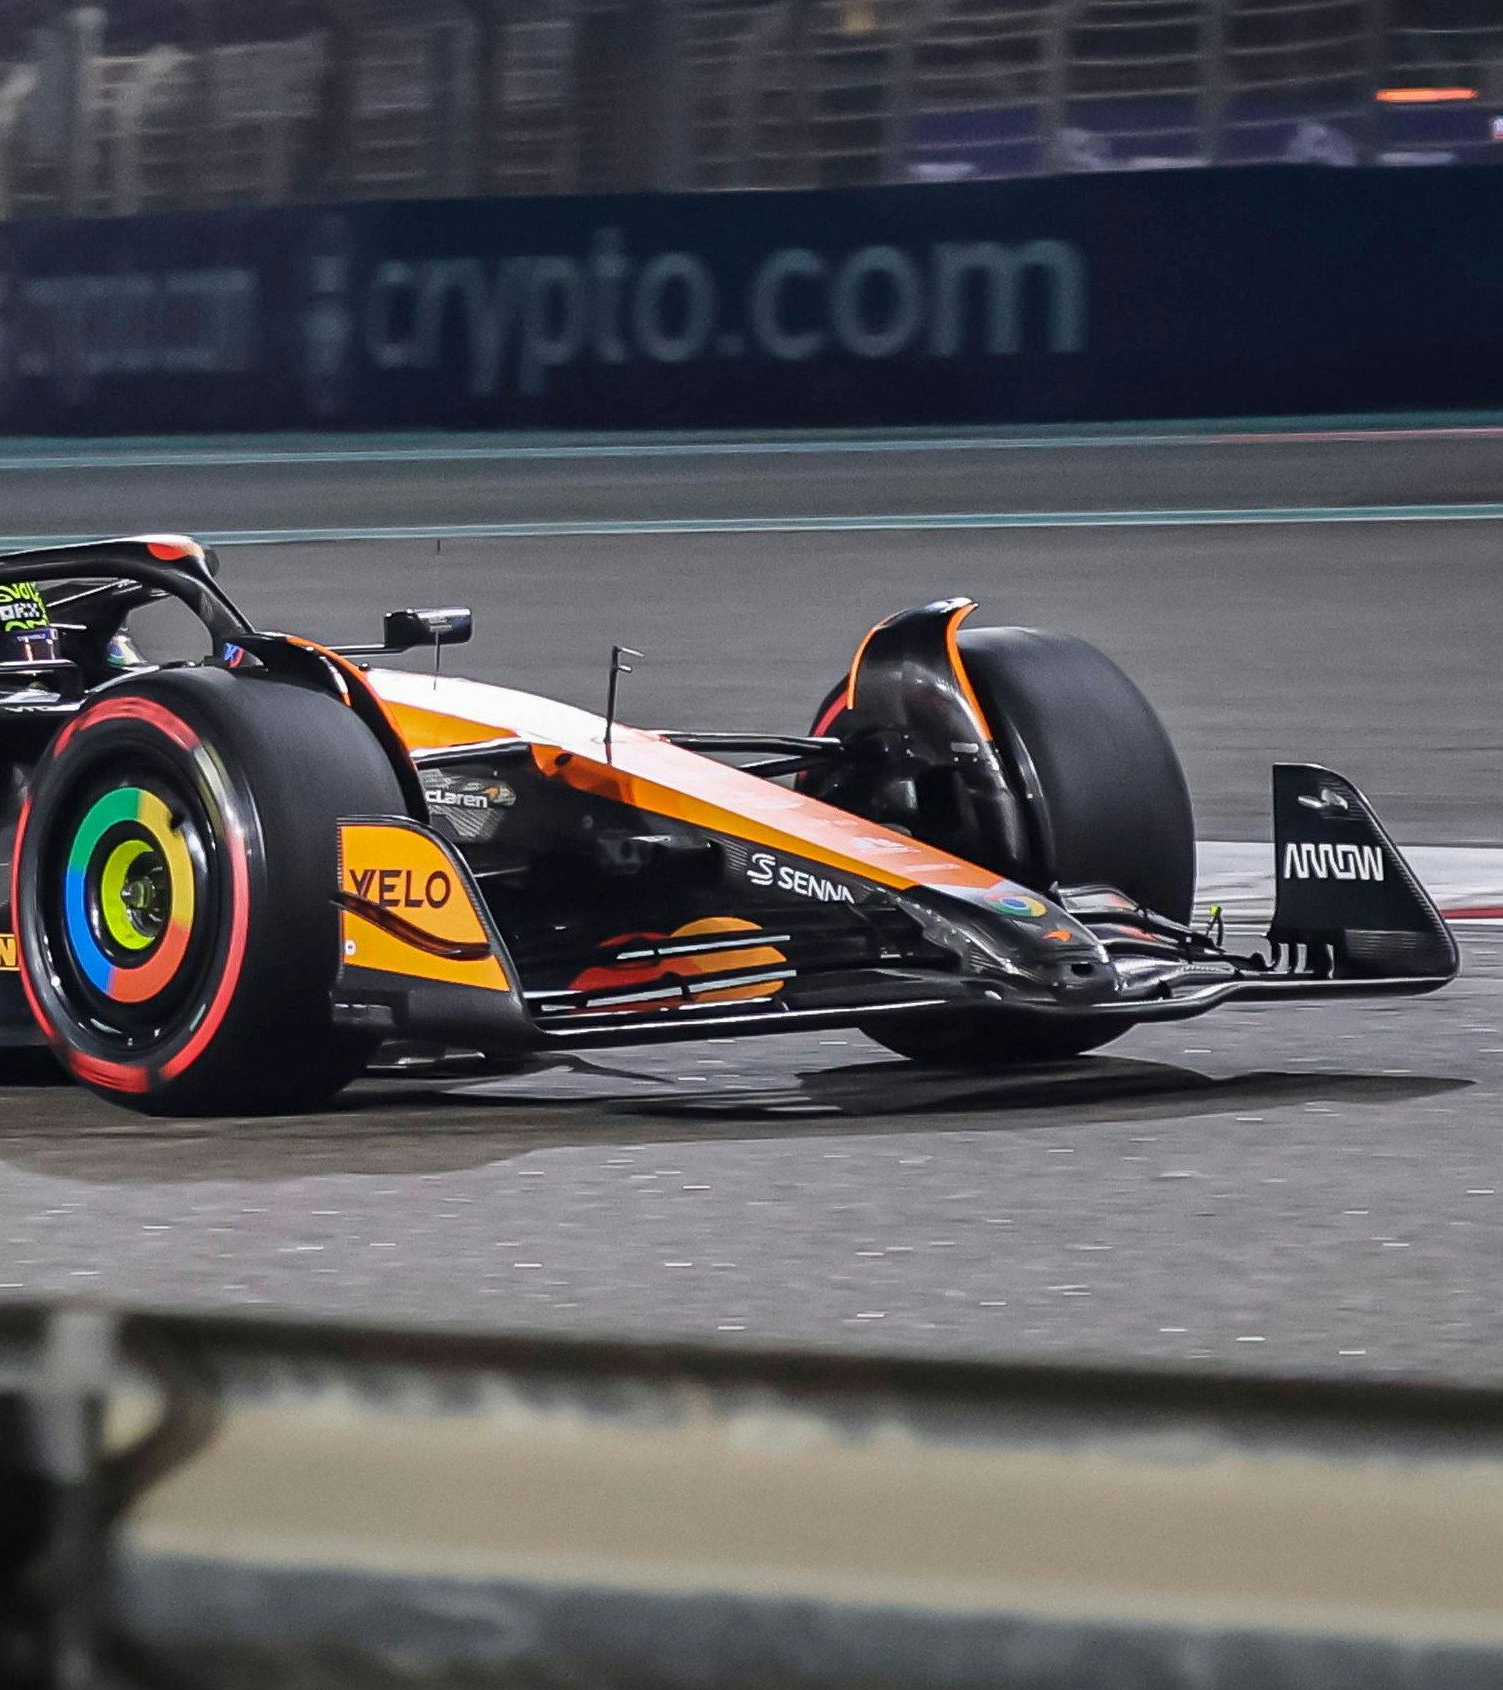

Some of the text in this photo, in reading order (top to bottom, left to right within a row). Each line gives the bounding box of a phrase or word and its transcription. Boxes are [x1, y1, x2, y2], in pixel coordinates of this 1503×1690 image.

[365, 230, 1090, 396] crypto.com
[424, 789, 488, 808] cLaren
[349, 869, 451, 909] VELO
[778, 866, 855, 904] SENNA
